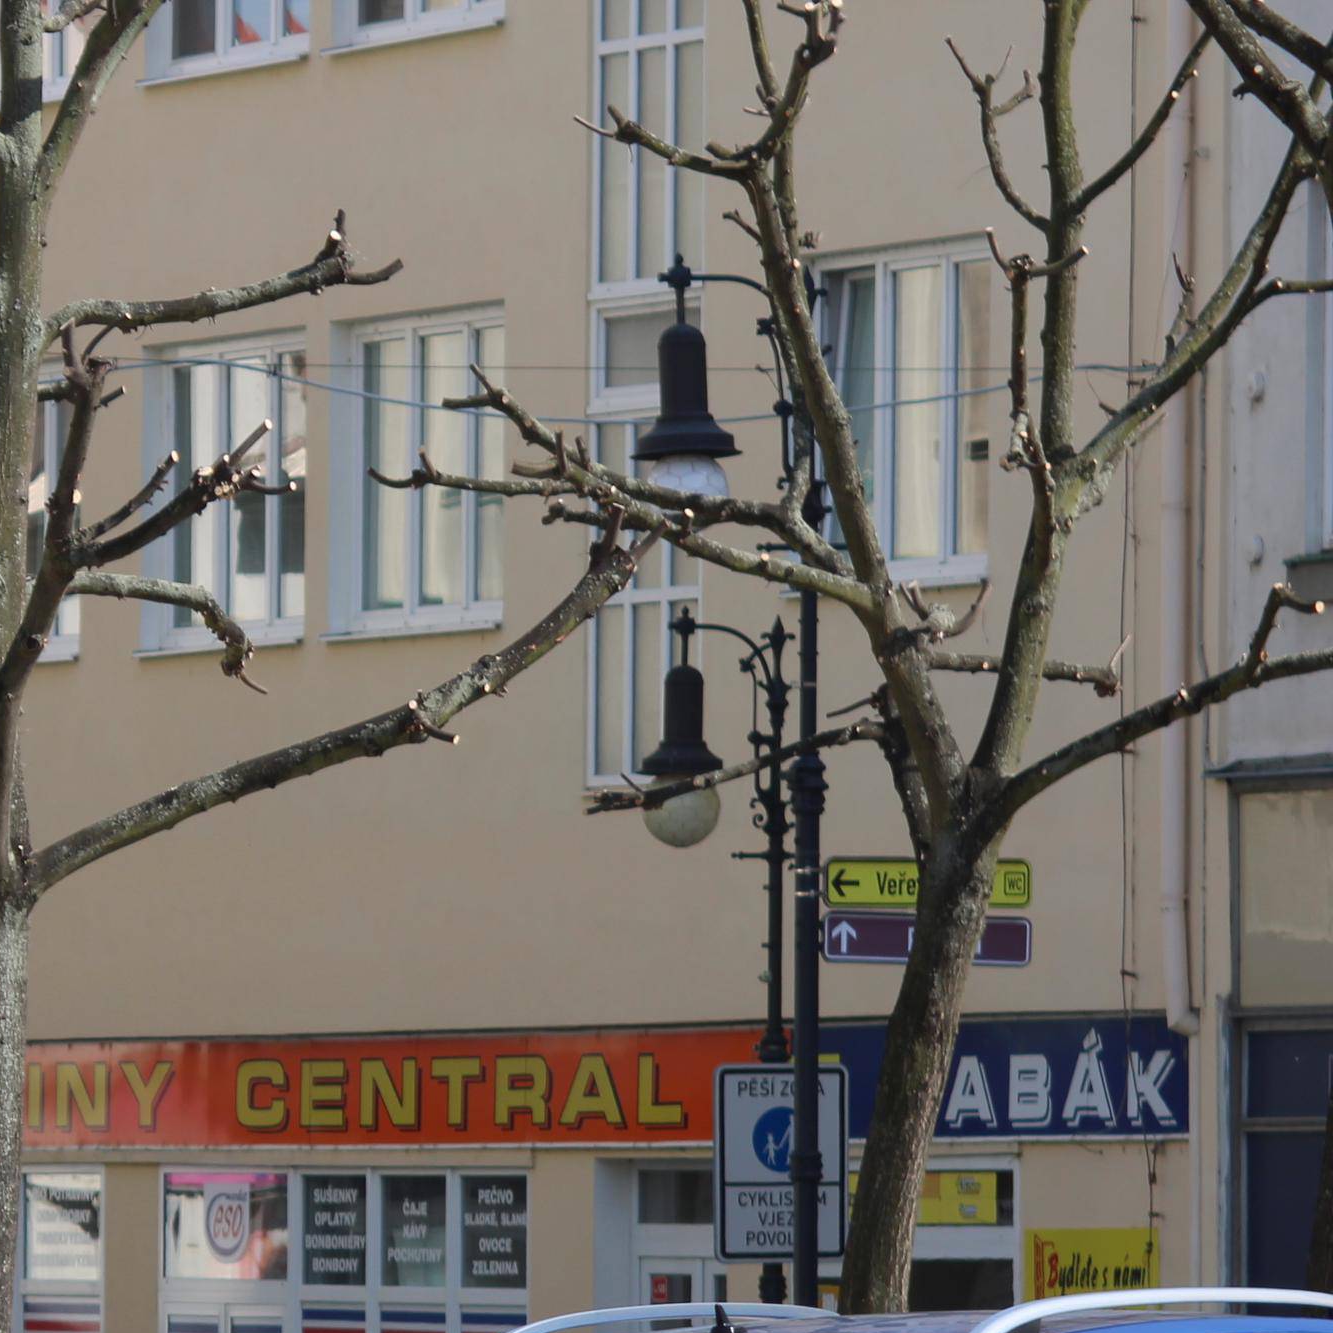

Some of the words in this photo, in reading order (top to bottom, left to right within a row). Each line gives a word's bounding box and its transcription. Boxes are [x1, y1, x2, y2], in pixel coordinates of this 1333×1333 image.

[945, 1027, 1177, 1128] ABÁK
[235, 1051, 687, 1131] CENTRAL
[737, 1077, 775, 1098] PĚŠÍ
[780, 1080, 825, 1097] ZA
[313, 1184, 358, 1203] SUŠENKY
[477, 1185, 514, 1205] PEČIVO
[738, 1191, 827, 1207] CYKLISM
[402, 1197, 428, 1217] ČAJE
[314, 1211, 357, 1227] OPLATKY
[758, 1211, 794, 1227] VJEZ
[402, 1223, 427, 1240] KÁVY
[746, 1231, 794, 1247] POVOL
[479, 1237, 513, 1254] OVOCE
[312, 1257, 359, 1274] BONBONY
[472, 1259, 519, 1277] ZELENINA
